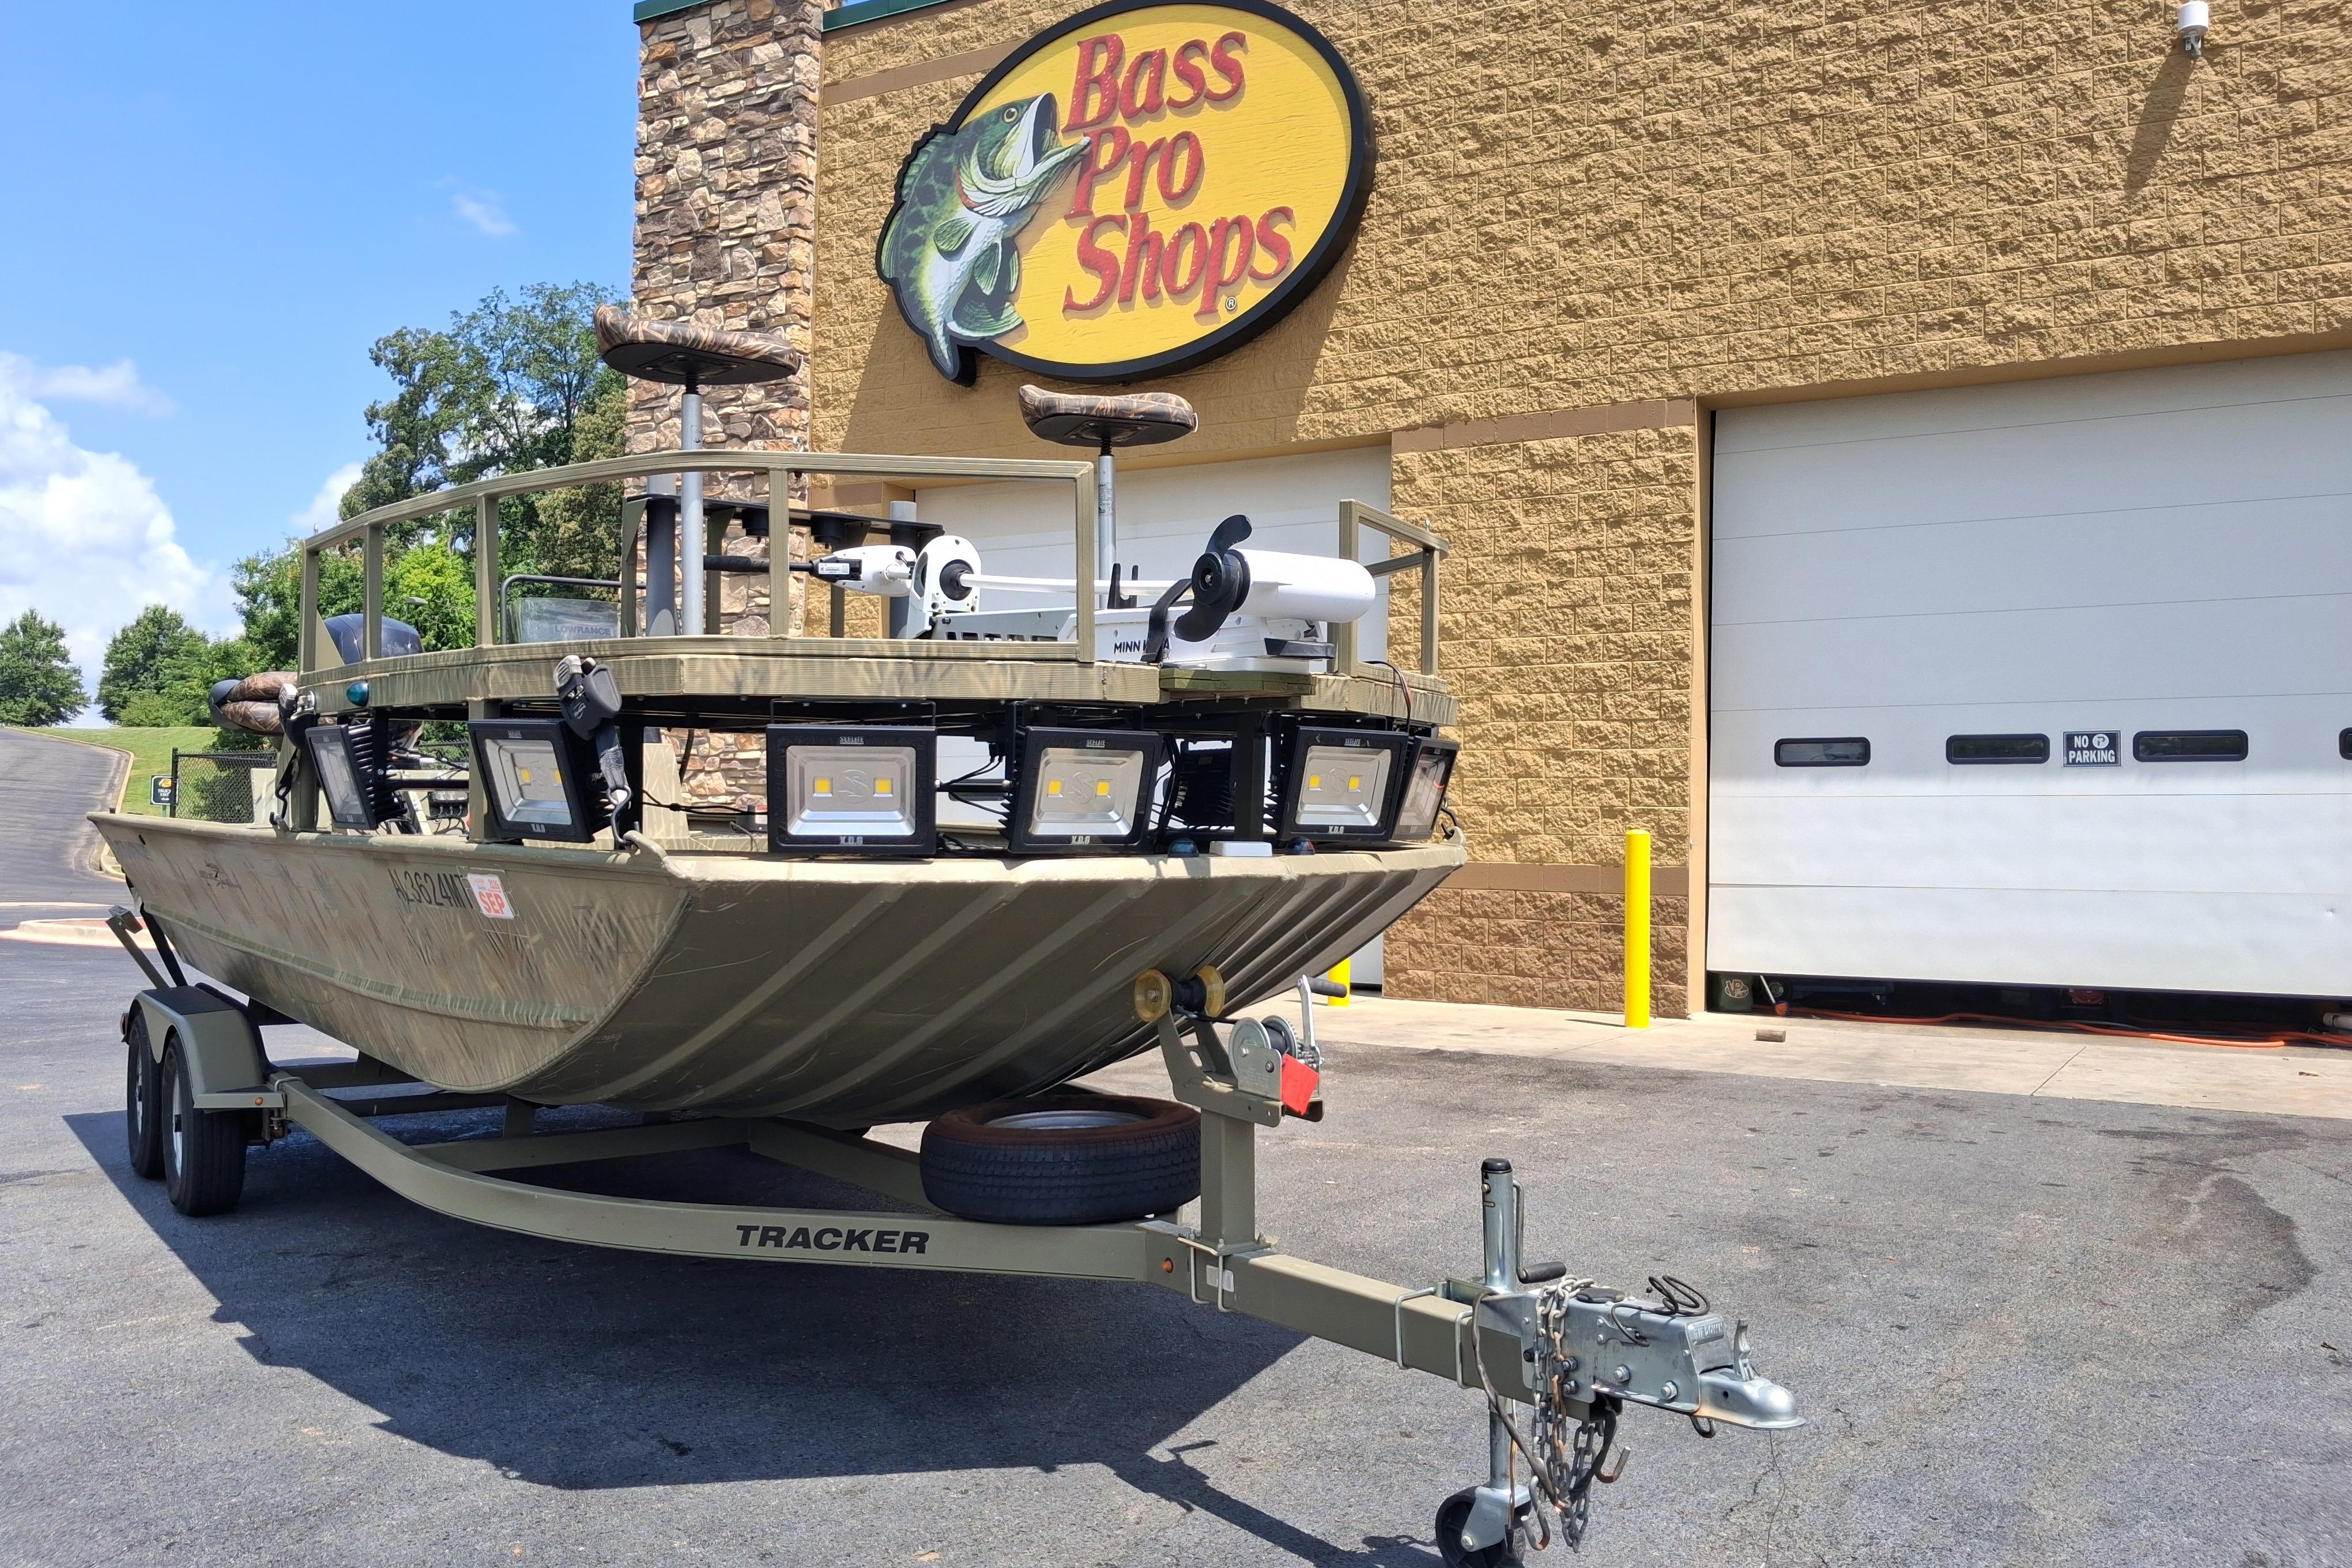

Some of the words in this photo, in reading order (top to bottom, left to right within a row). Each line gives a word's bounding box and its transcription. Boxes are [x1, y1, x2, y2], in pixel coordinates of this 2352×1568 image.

[1061, 32, 1247, 133] Bass
[1065, 125, 1203, 220] Pro
[1062, 206, 1294, 316] Shops
[555, 624, 612, 635] LOWRANCE
[1114, 640, 1141, 654] MINN
[2074, 735, 2089, 748] NO
[2069, 749, 2116, 763] PARKING
[478, 891, 505, 915] SEP
[736, 1224, 930, 1254] TRACKER
